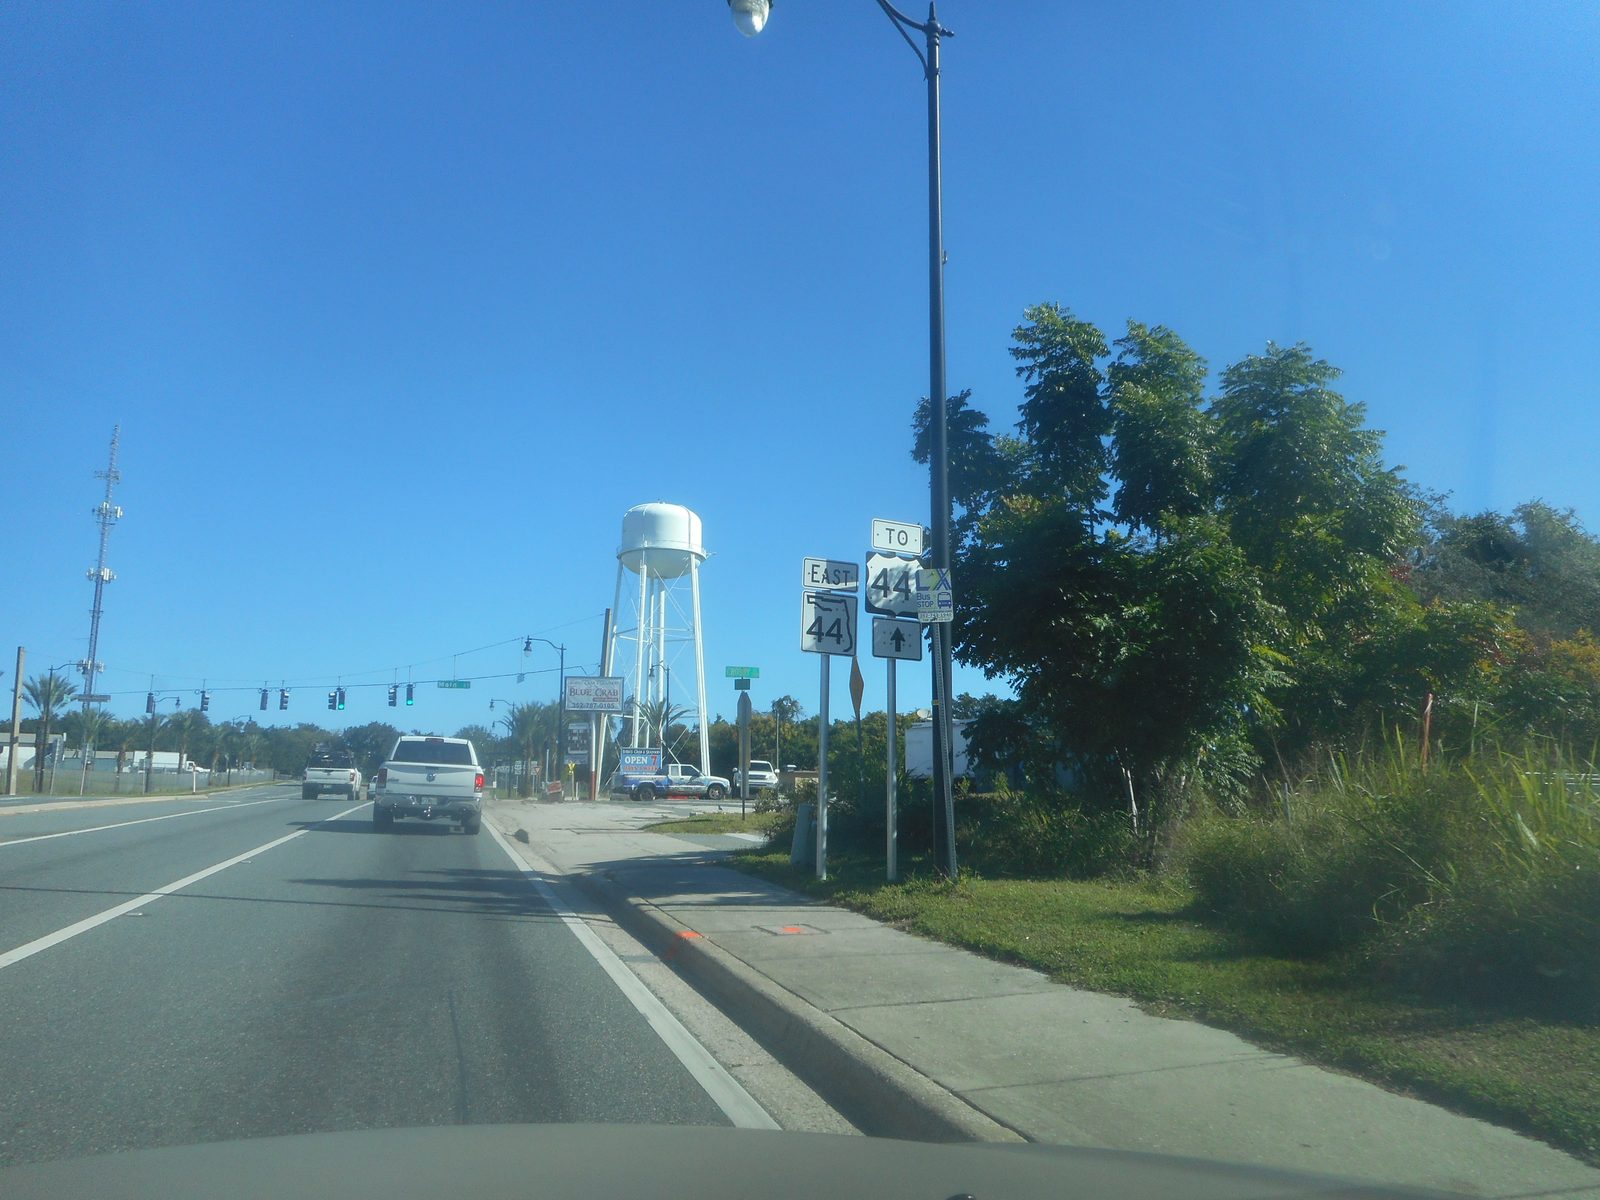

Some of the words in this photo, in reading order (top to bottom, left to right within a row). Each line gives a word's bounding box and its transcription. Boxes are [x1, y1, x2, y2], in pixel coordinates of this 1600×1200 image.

[885, 528, 908, 546] TO
[811, 564, 851, 586] EAST
[870, 567, 912, 601] 44
[806, 616, 844, 645] 44
[569, 687, 592, 697] BLUE
[595, 688, 618, 697] CRAB
[624, 756, 648, 764] OPEN
[651, 755, 657, 766] 7
